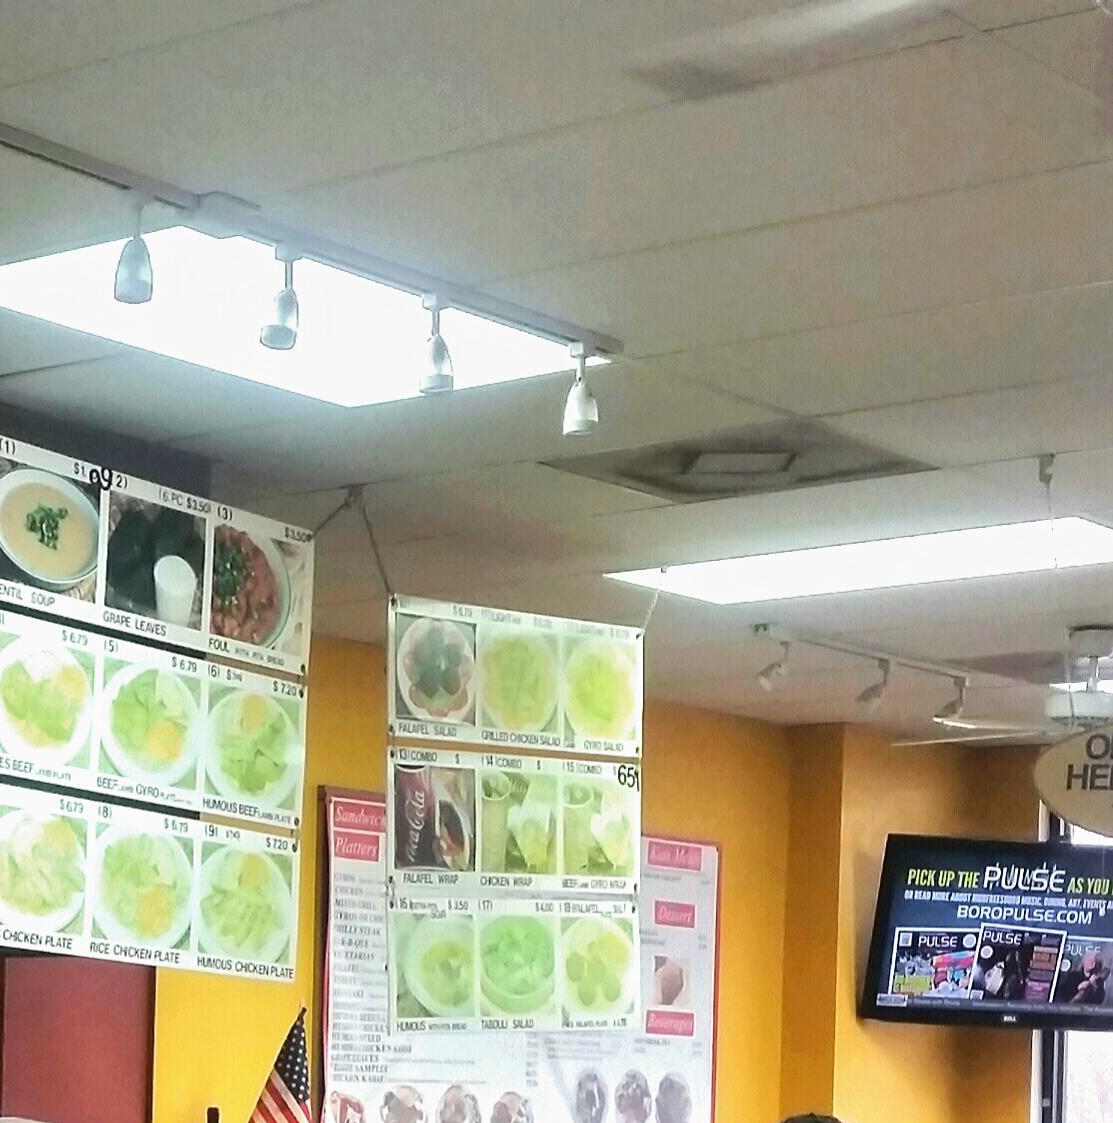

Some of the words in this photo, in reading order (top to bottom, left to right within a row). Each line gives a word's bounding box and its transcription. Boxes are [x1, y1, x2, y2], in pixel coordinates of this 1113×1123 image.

[31, 592, 55, 607] SOUP
[103, 611, 131, 629] GRAPE
[135, 619, 167, 637] LEAVES
[208, 638, 230, 653] FOUL
[398, 722, 429, 735] FALAFEL
[434, 726, 456, 737] SALAD
[481, 730, 509, 742] GRILLED
[510, 732, 539, 745] CHICKEN
[539, 735, 560, 746] SALAD
[603, 741, 623, 752] SALAD
[410, 749, 437, 762] COMBO
[497, 756, 521, 768] COMBO
[202, 798, 238, 814] HUMOUS
[336, 839, 378, 858] Platters
[404, 873, 433, 884] FALAFEL
[439, 874, 459, 885] WRAP
[480, 876, 509, 886] CHICKEN
[513, 877, 533, 887] WRAP
[562, 879, 578, 888] BEEF
[609, 880, 626, 889] WRAP
[907, 869, 936, 885] PICK
[938, 870, 956, 887] UP
[958, 872, 980, 888] THE
[983, 865, 1066, 893] PULSE
[1067, 878, 1083, 893] AS
[1088, 878, 1109, 895] YOU
[957, 905, 1093, 924] BOROPULSE.COM
[3, 928, 42, 946] CHICKEN
[43, 936, 72, 950] PLATE
[919, 936, 957, 947] PULSE
[983, 931, 1022, 945] PULSE
[113, 944, 152, 960] CHICKEN
[154, 950, 180, 964] PLATE
[197, 956, 232, 971] HUMOUS
[235, 960, 269, 976] CHICKEN
[270, 966, 294, 979] PLATE
[397, 1021, 425, 1031] HUMOUS
[481, 1019, 508, 1030] TABOULI
[513, 1019, 534, 1029] SALAD
[648, 1013, 693, 1033] Beverages
